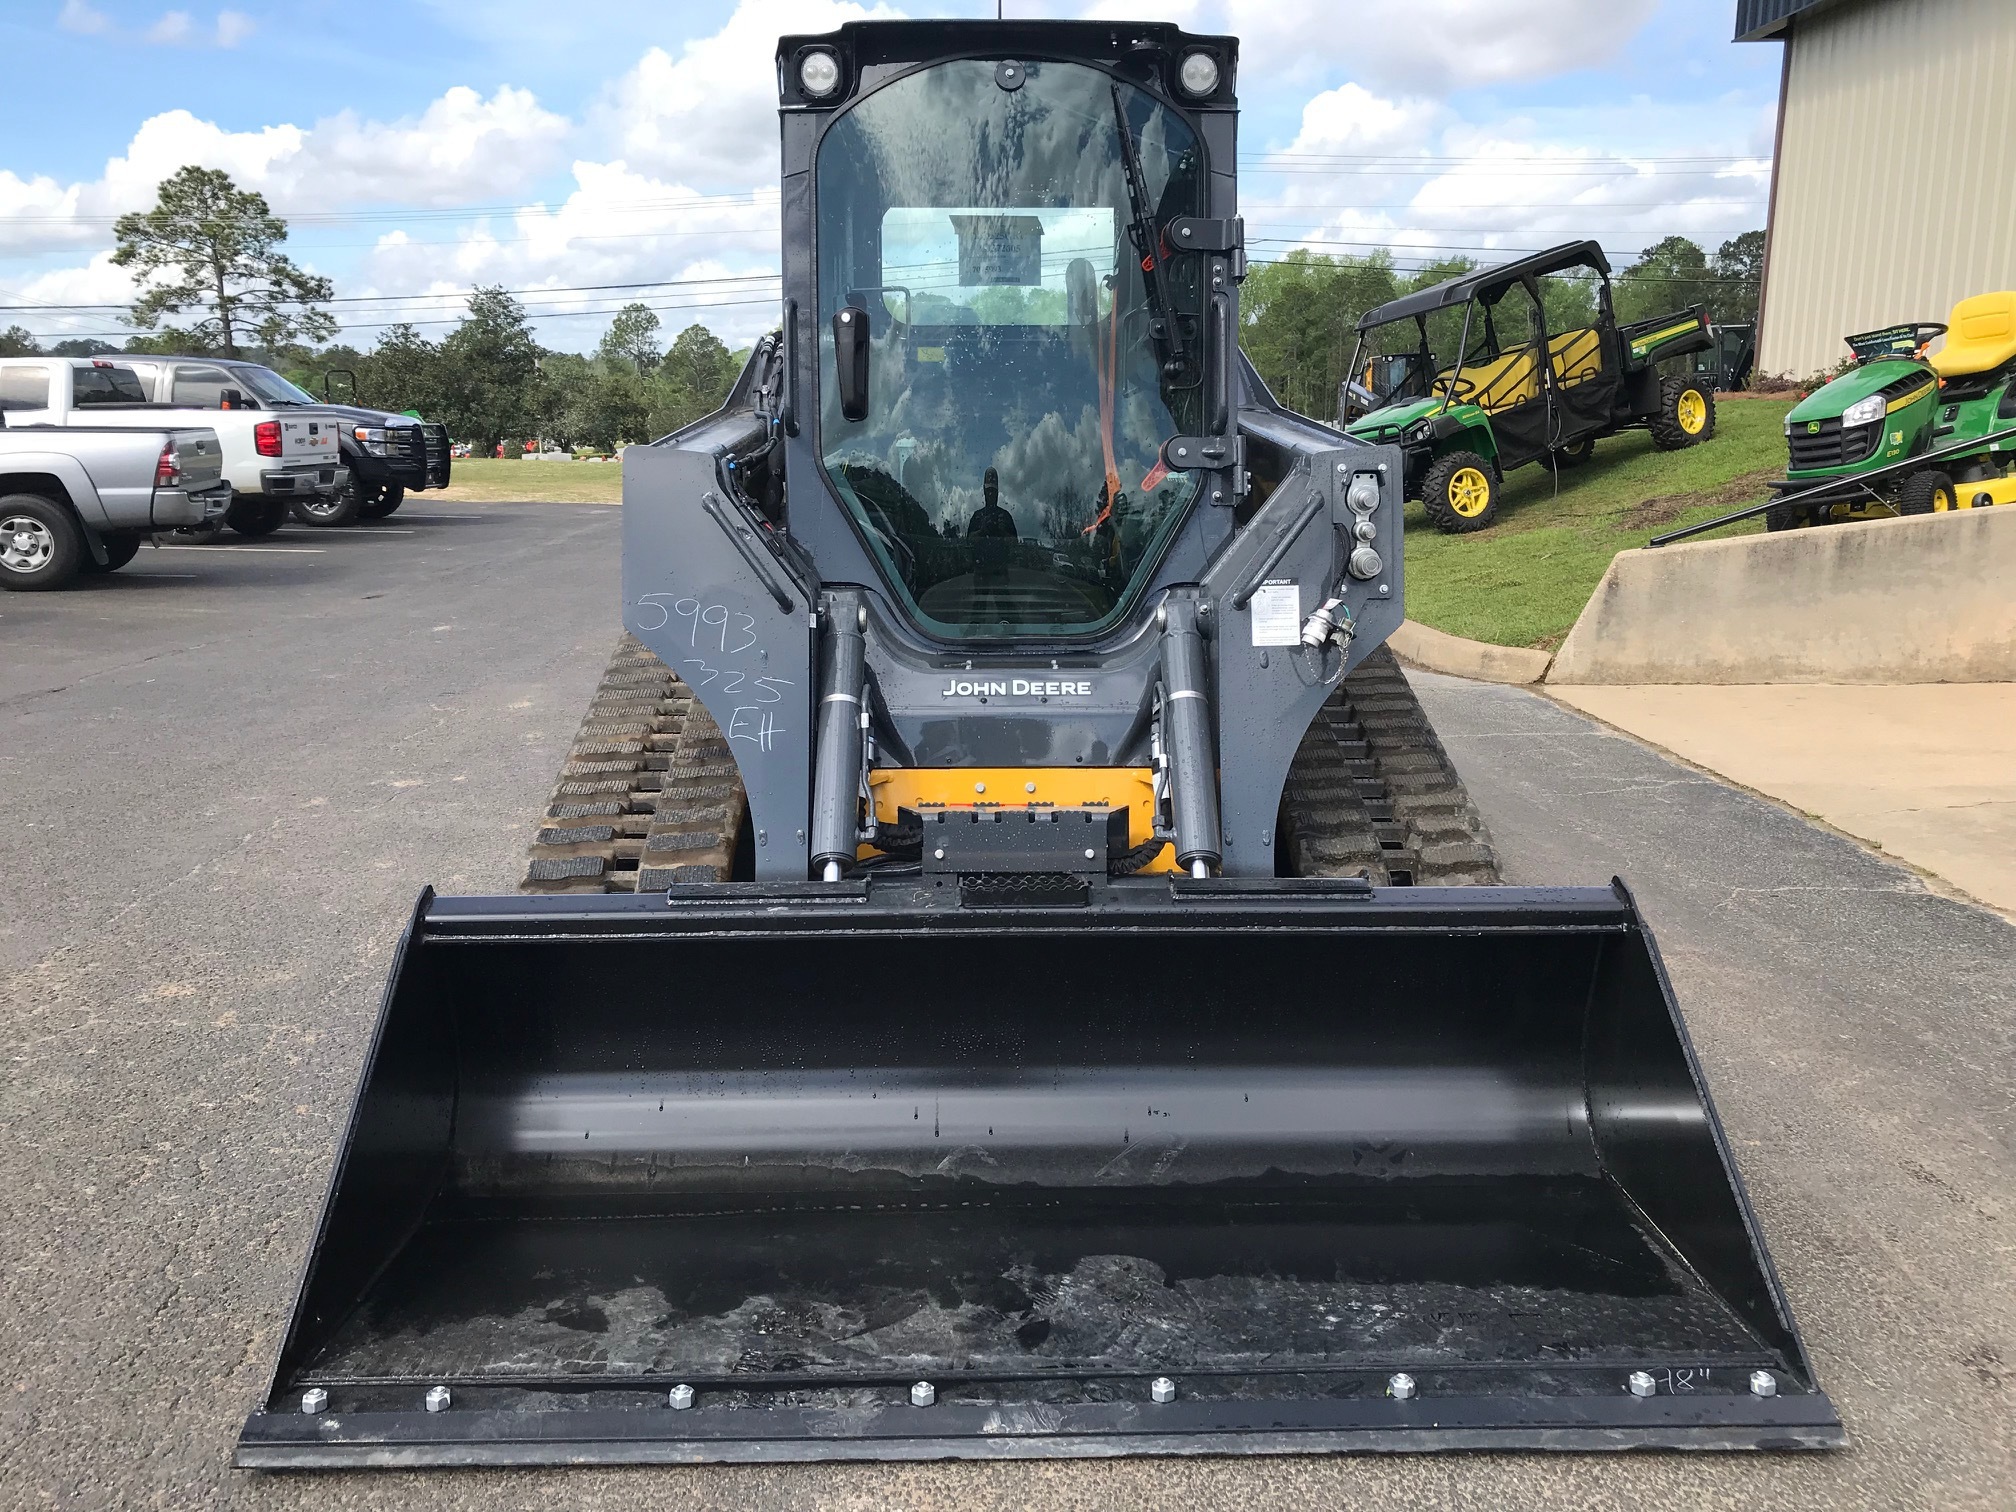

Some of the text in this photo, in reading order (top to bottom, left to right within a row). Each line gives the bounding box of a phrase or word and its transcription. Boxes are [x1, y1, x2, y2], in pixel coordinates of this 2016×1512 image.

[637, 593, 757, 654] 5993
[683, 659, 795, 703] 325
[942, 679, 1092, 696] JOHN DEERE
